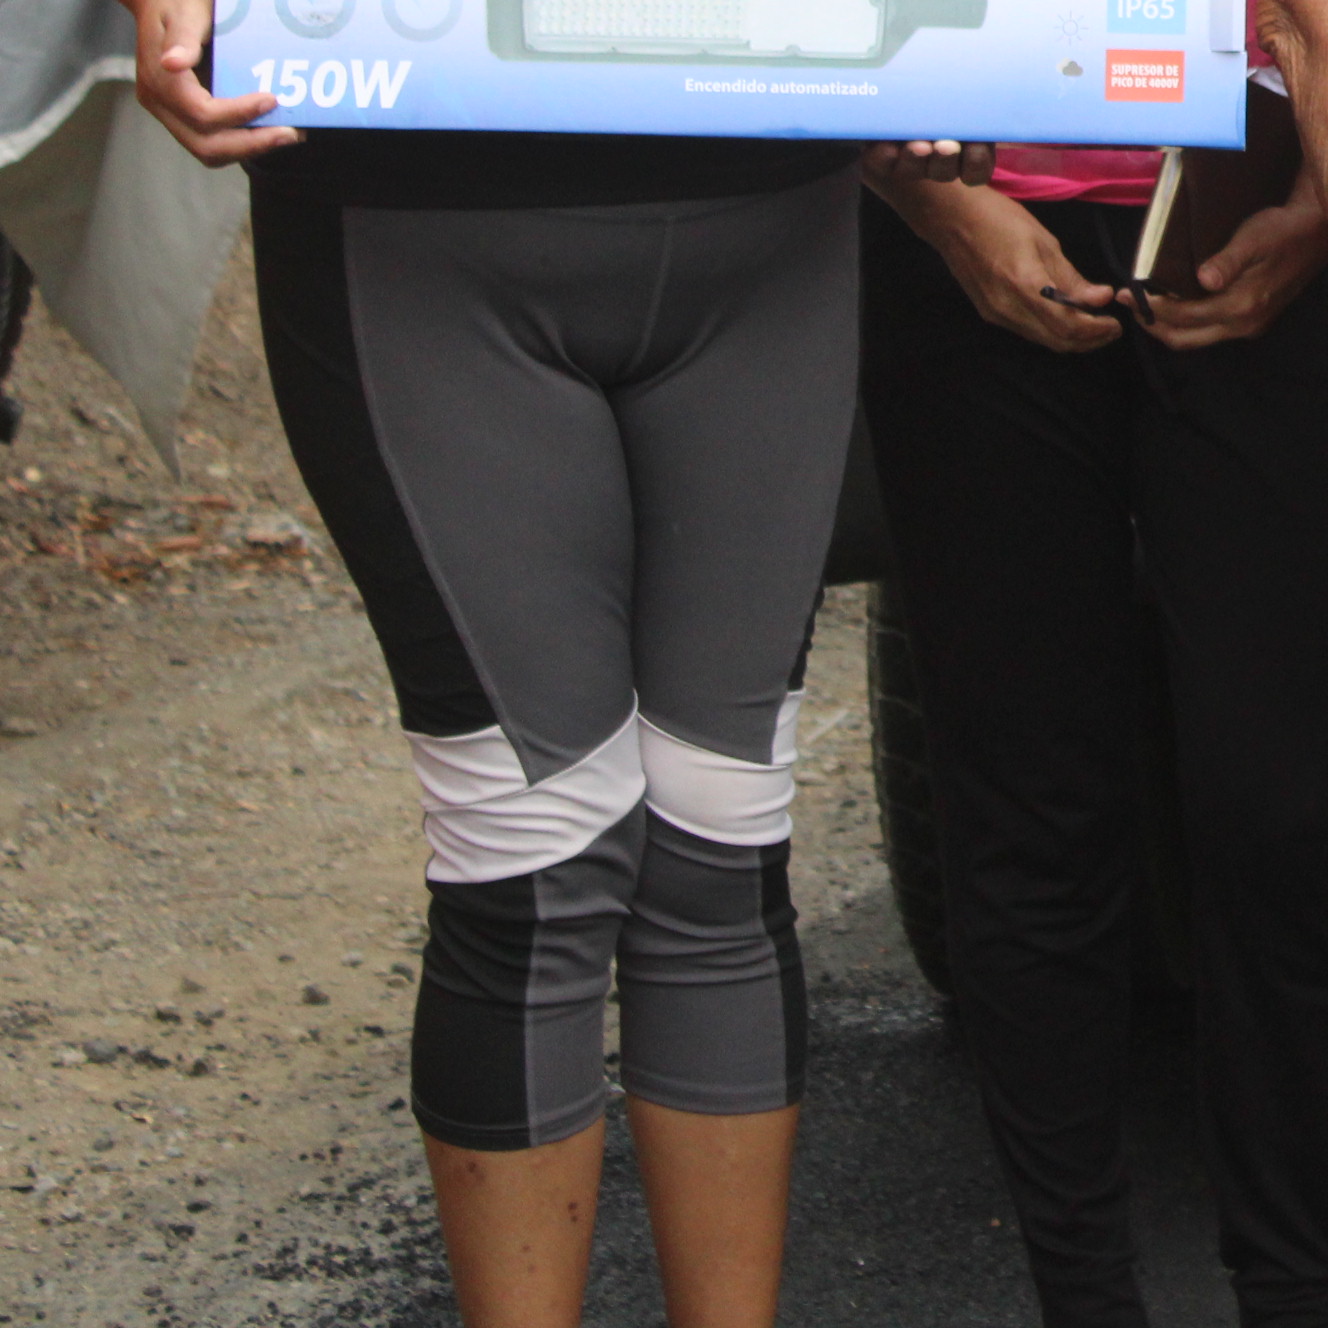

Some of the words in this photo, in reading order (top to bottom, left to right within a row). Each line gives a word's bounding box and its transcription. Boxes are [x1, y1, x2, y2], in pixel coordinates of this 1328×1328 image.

[1111, 63, 1164, 77] SUPRESOR
[1165, 64, 1180, 77] DE
[250, 58, 413, 110] 150W
[684, 78, 767, 93] Encendido
[769, 80, 879, 96] automatizado
[1111, 76, 1134, 88] PICO
[1135, 77, 1148, 88] DE
[1149, 77, 1180, 89] 4000V
